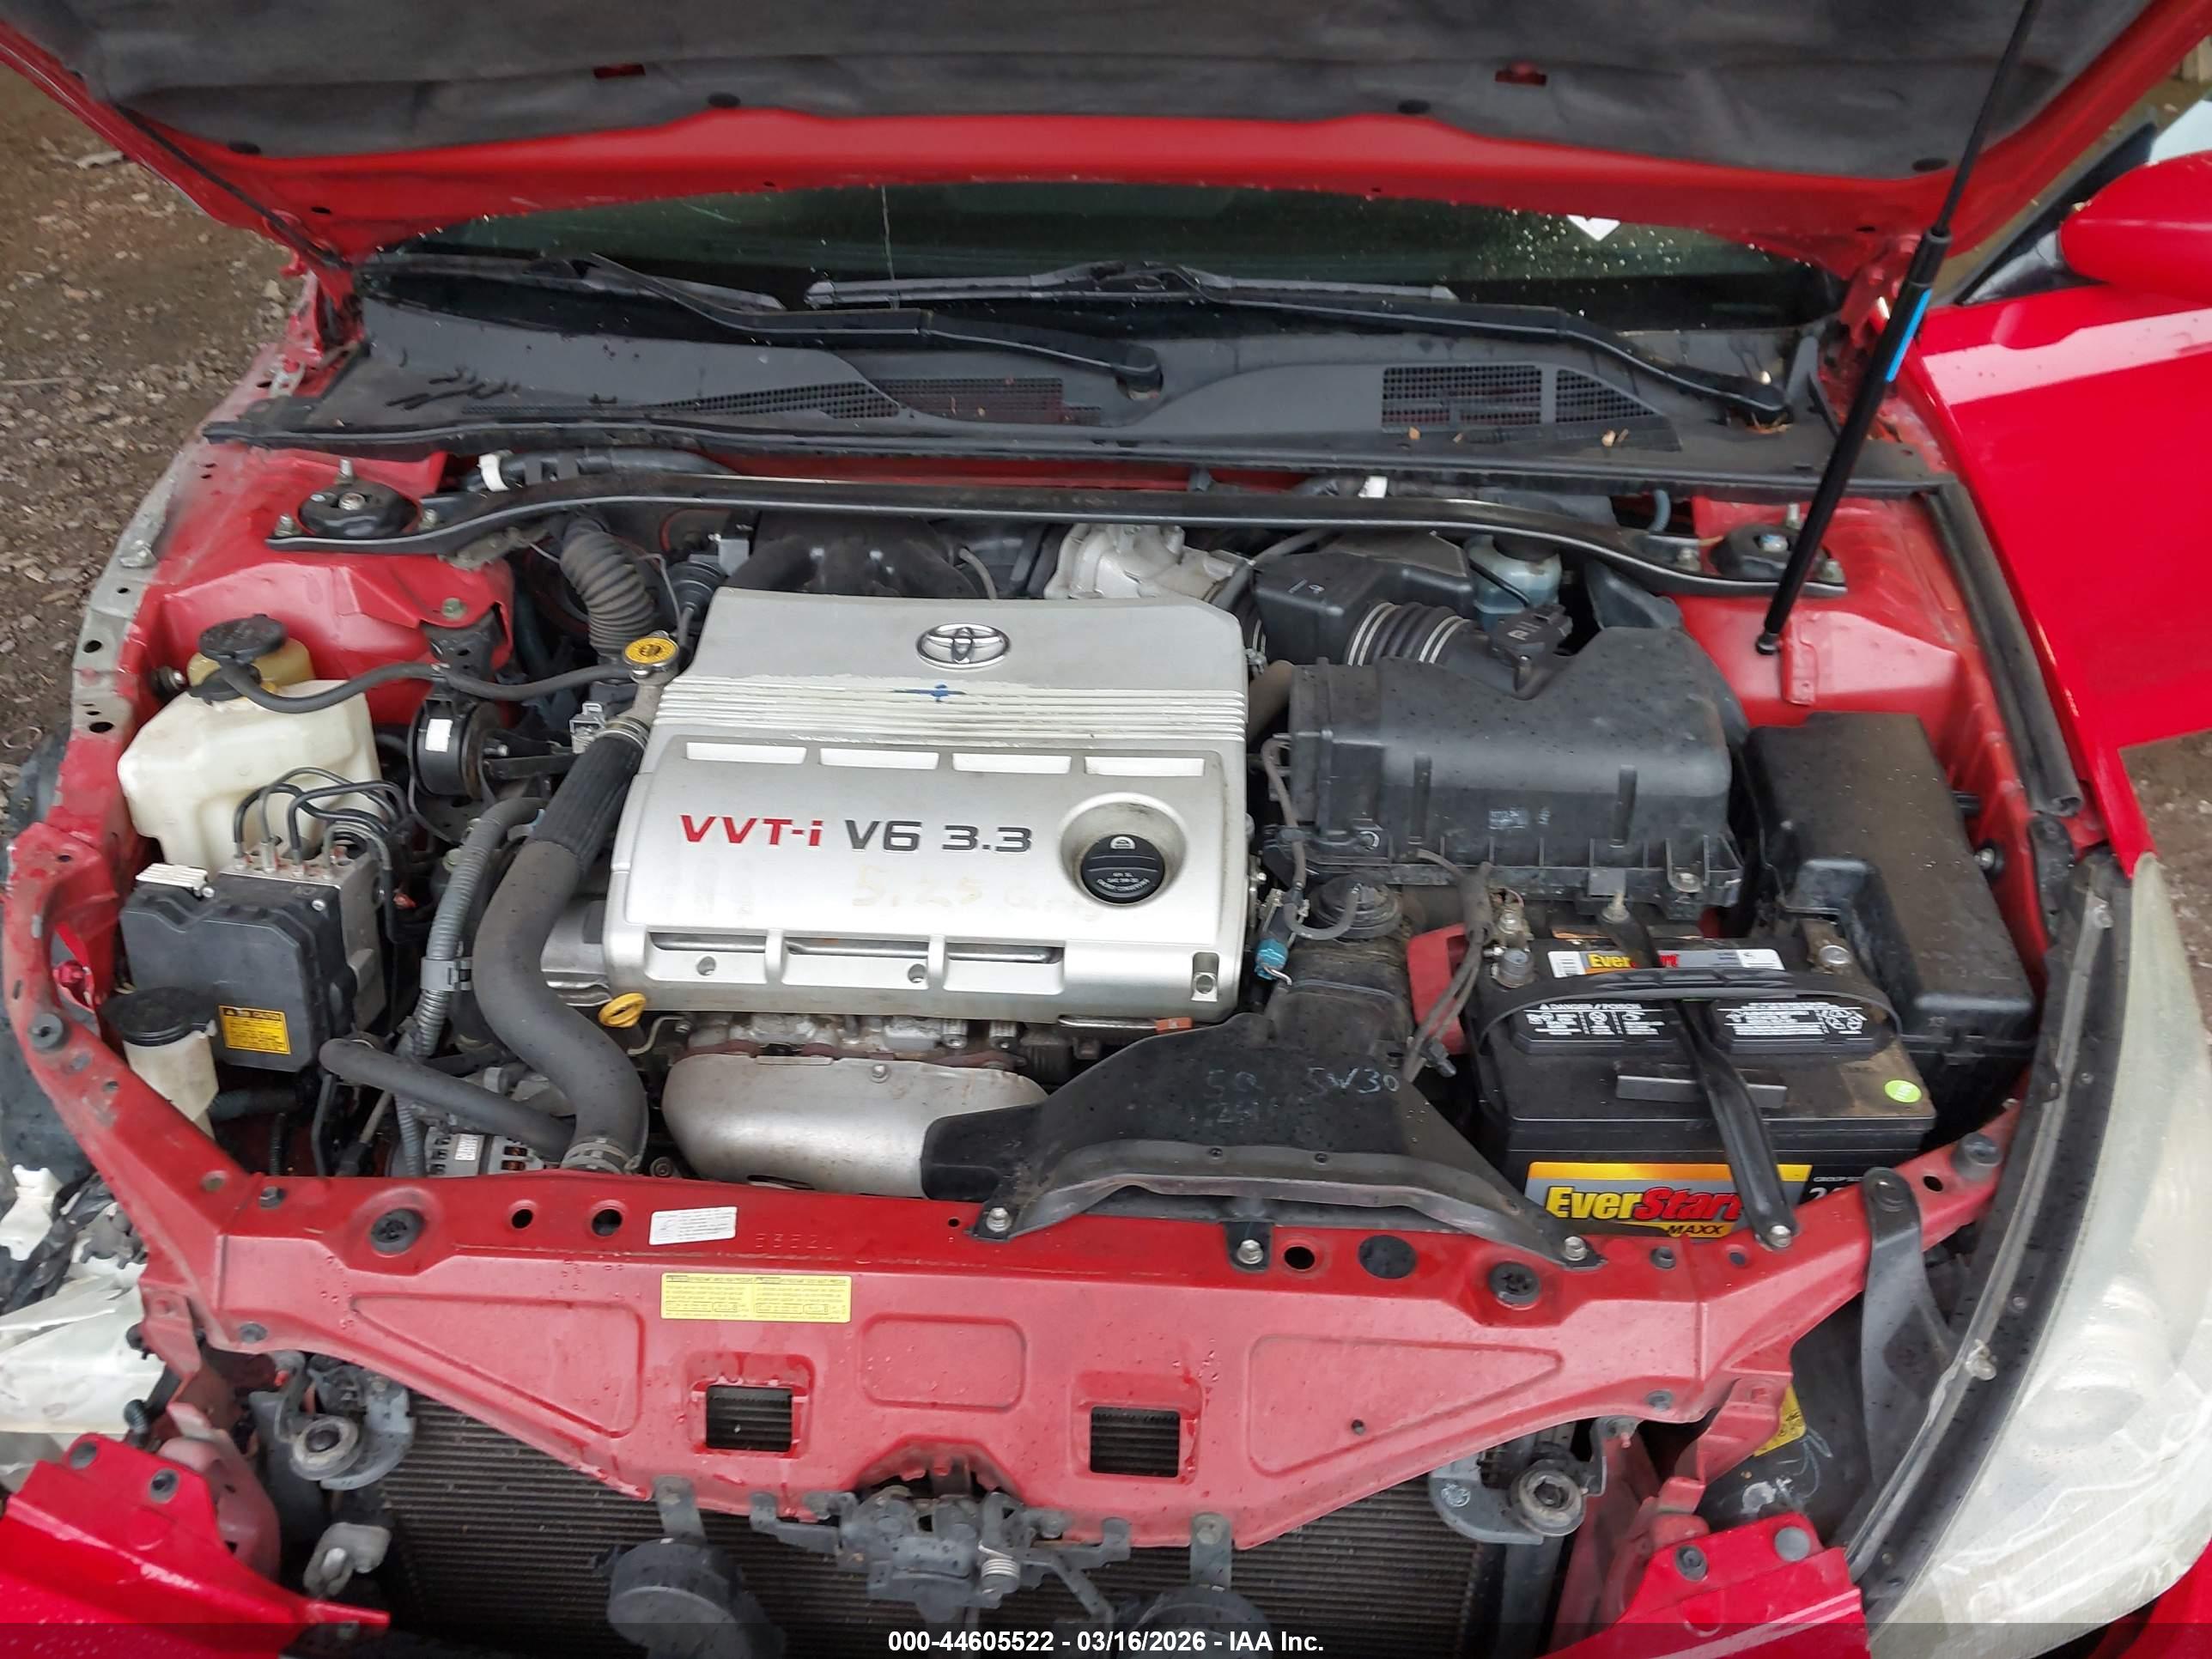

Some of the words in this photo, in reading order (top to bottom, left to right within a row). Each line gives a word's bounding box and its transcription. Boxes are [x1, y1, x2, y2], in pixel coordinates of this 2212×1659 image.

[680, 814, 823, 848] VVT-i
[843, 818, 924, 853] V6
[942, 824, 1033, 854] 3.3
[1666, 1224, 1723, 1236] MAXX
